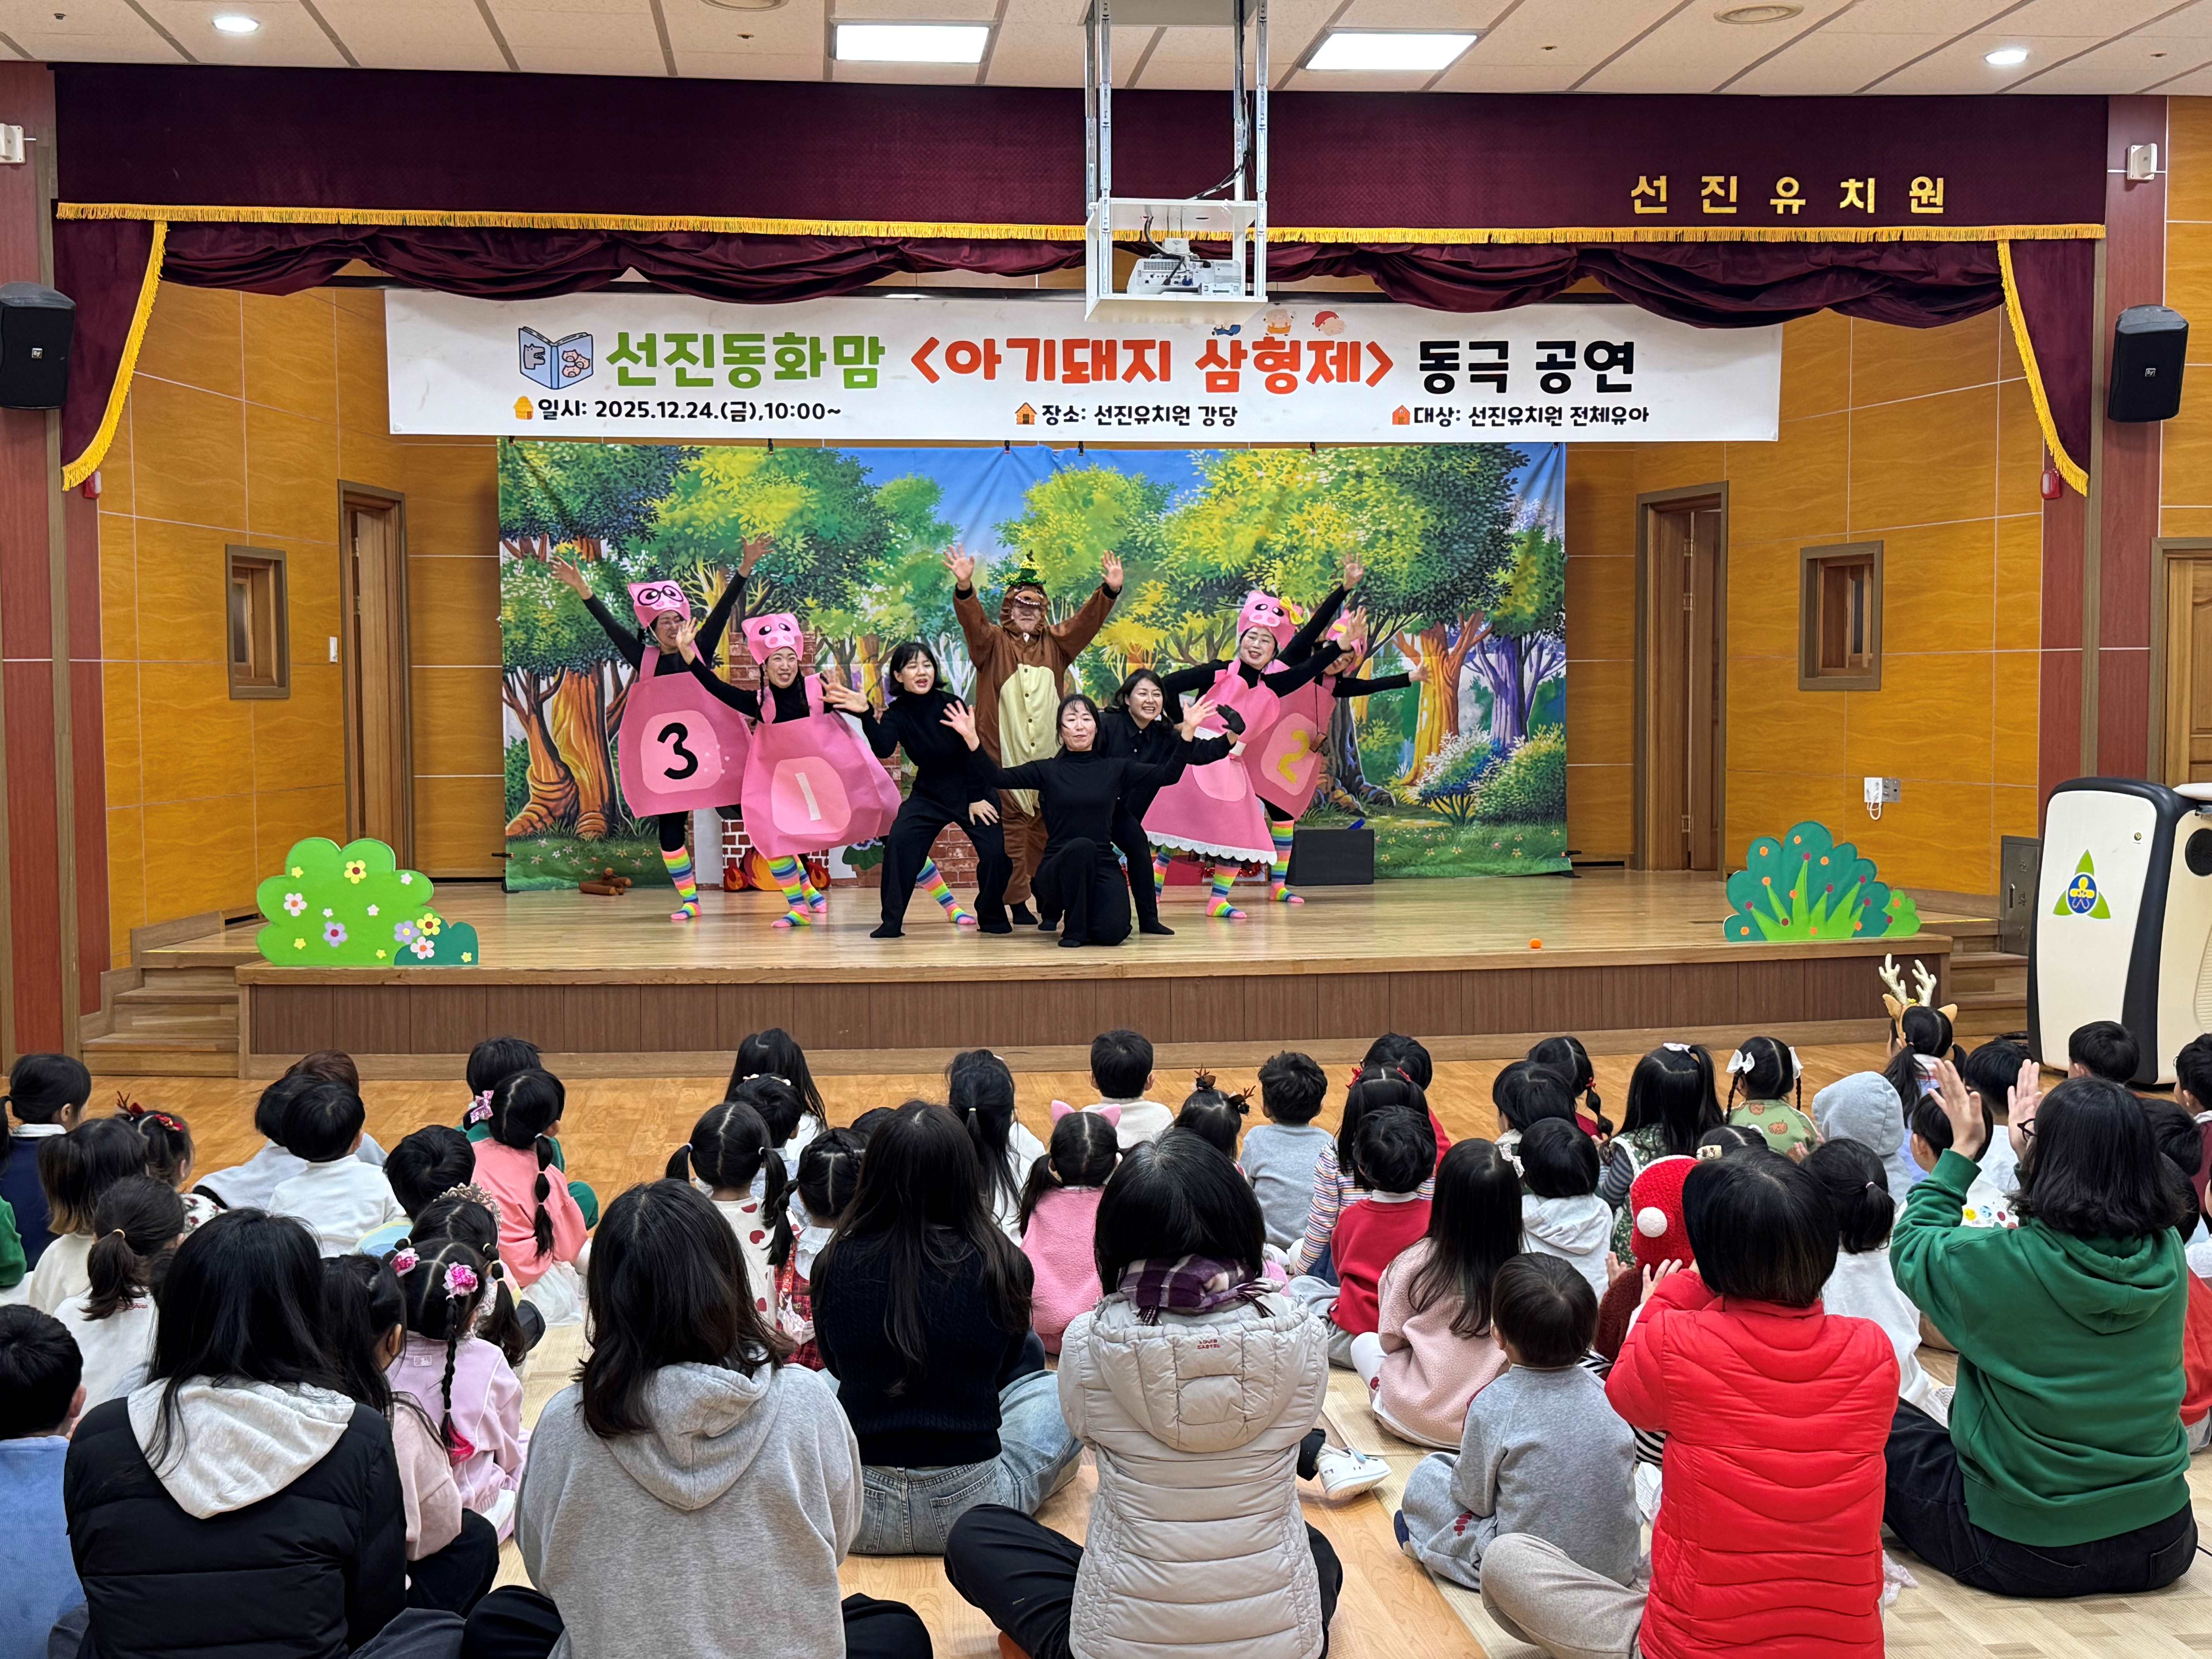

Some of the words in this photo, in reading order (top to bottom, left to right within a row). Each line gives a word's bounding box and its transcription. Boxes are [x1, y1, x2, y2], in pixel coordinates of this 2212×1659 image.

[606, 332, 885, 389] 선진동화맘
[911, 336, 1171, 384] <아기돼지
[1195, 336, 1393, 394] 삼형제>
[1419, 340, 1509, 394] 동극
[1535, 340, 1634, 394] 공연
[538, 398, 587, 420] 일시:
[594, 400, 841, 422] 2025.12.24.(금),10:00~
[1042, 405, 1086, 426] 장소:
[1094, 405, 1190, 426] 선진유치원
[1198, 405, 1238, 426] 강당
[1414, 406, 1460, 427] 대상:
[1468, 405, 1563, 426] 선진유치원
[1570, 405, 1649, 426] 전체유아
[657, 722, 698, 780] 3
[1278, 729, 1310, 785] 2
[795, 772, 821, 821] 1
